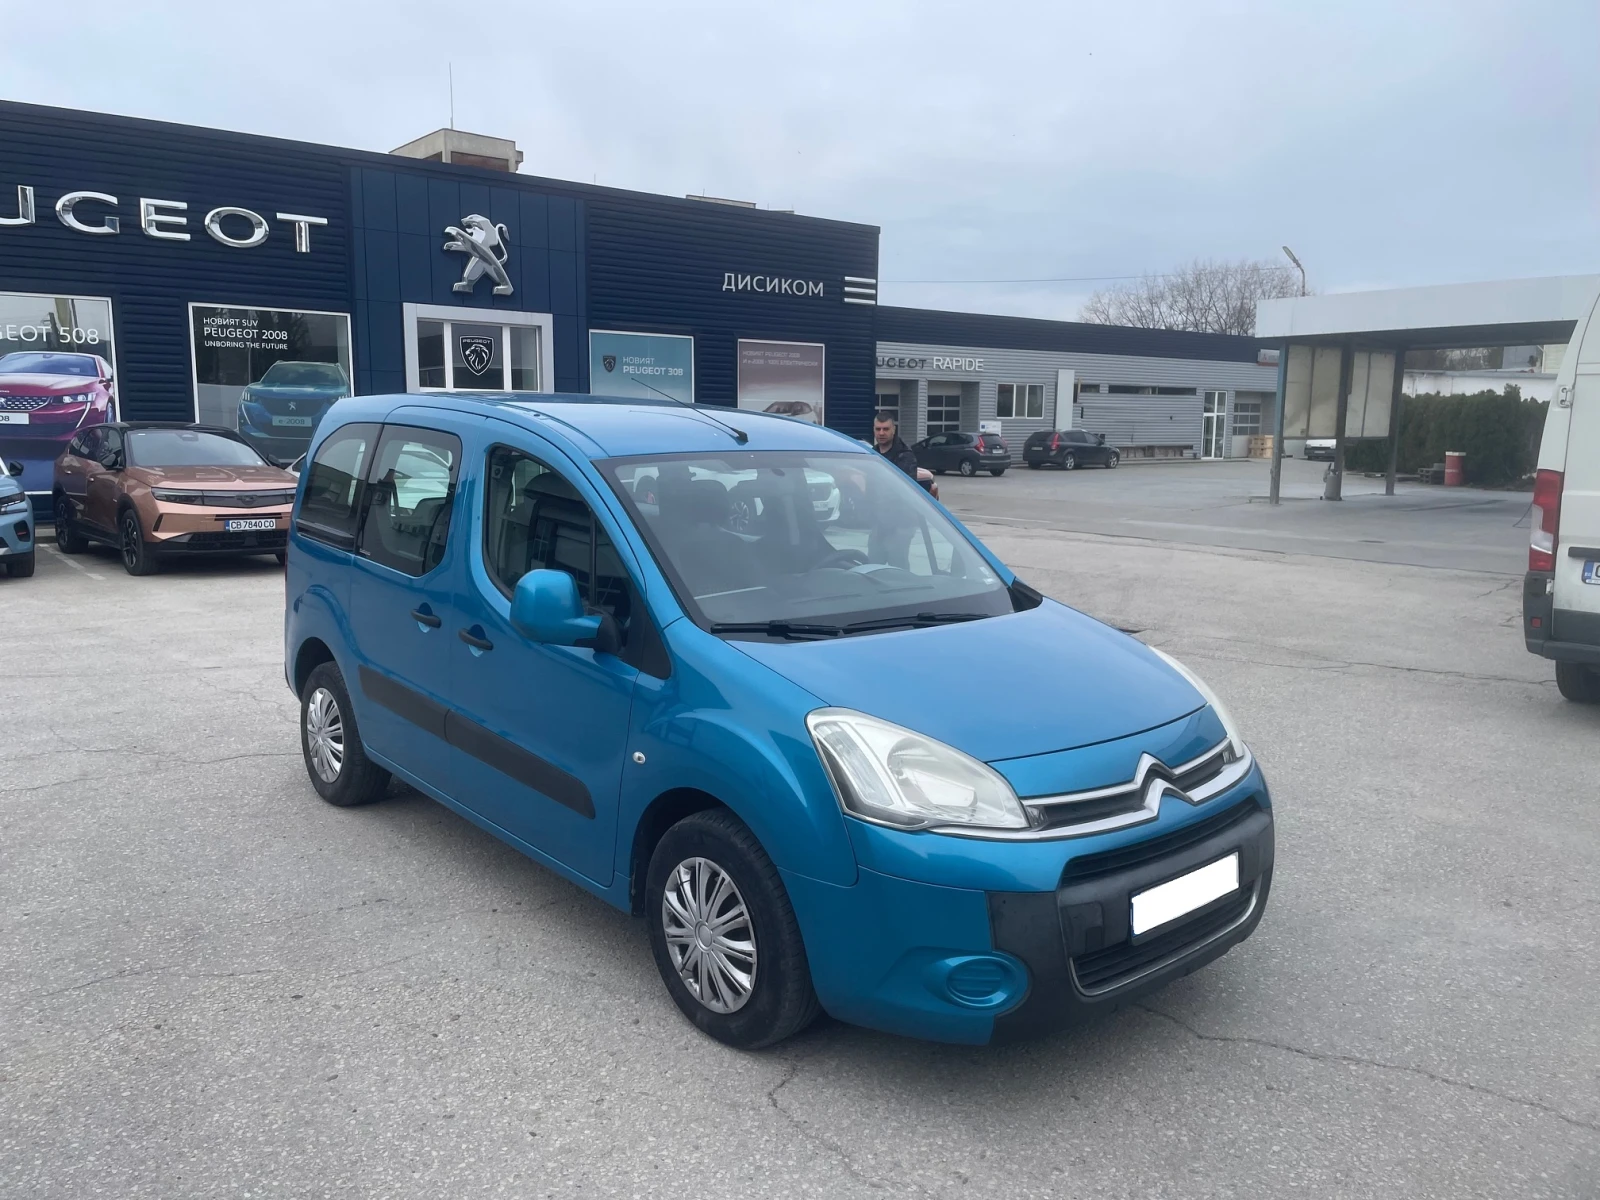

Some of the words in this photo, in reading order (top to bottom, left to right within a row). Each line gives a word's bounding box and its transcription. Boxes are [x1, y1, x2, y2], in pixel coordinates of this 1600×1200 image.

[722, 272, 824, 297] ДИСИКОМ
[203, 317, 240, 326] НОВИЯТ
[241, 319, 259, 327] SUV
[0, 324, 51, 342] EOT
[59, 326, 99, 345] 508
[203, 327, 259, 339] PEUGEOT
[261, 329, 288, 340] 2008
[204, 340, 245, 348] UNBORING
[245, 341, 260, 349] THE
[261, 342, 288, 350] FUTURE
[622, 356, 655, 365] НОВИЯТ
[933, 356, 984, 371] RAPIDE
[622, 365, 667, 376] PEUGEOT
[667, 367, 684, 376] 308
